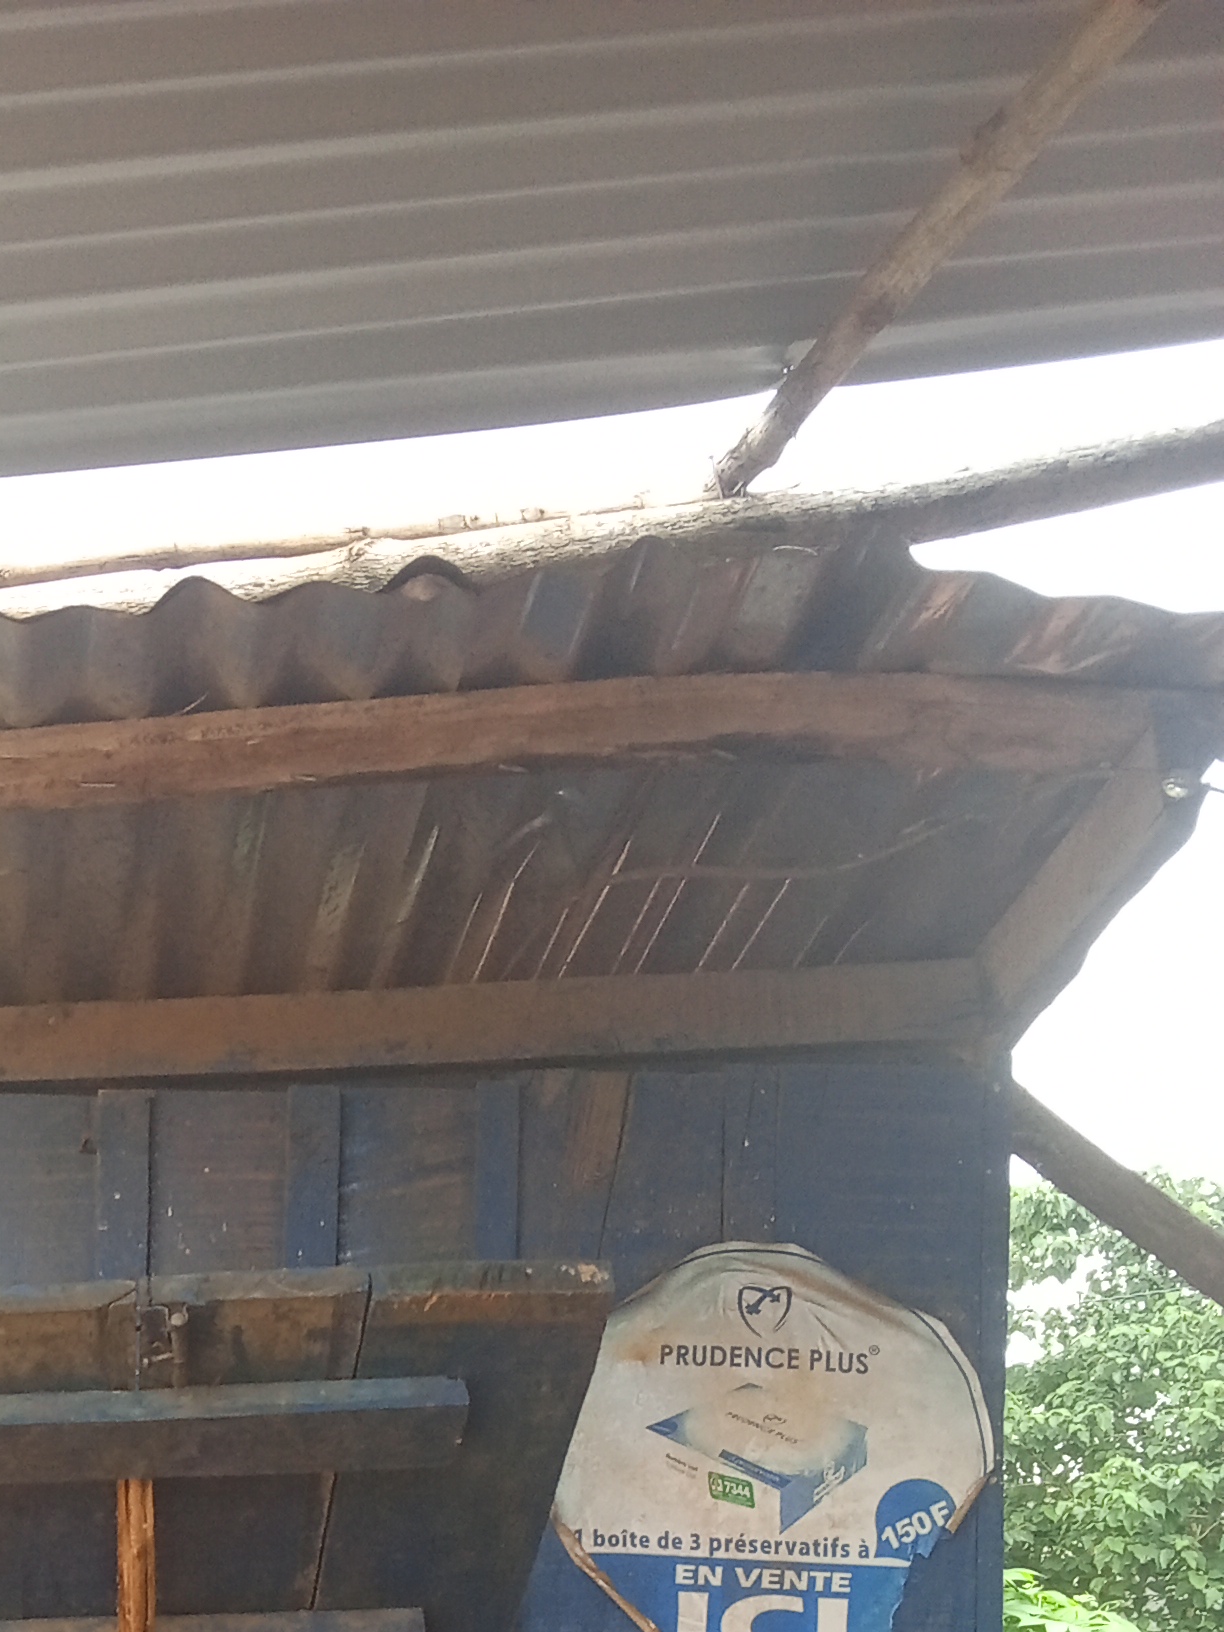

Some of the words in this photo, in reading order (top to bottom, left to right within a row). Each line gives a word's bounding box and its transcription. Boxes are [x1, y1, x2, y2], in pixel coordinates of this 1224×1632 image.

[659, 1344, 800, 1370] PRUDENCE
[809, 1348, 870, 1375] PLUS
[593, 1528, 650, 1549] boîte
[657, 1531, 683, 1550] de
[690, 1534, 701, 1550] 3
[709, 1533, 850, 1559] préservatifs
[858, 1538, 870, 1559] à
[675, 1564, 723, 1587] EN
[734, 1566, 852, 1593] VENTE
